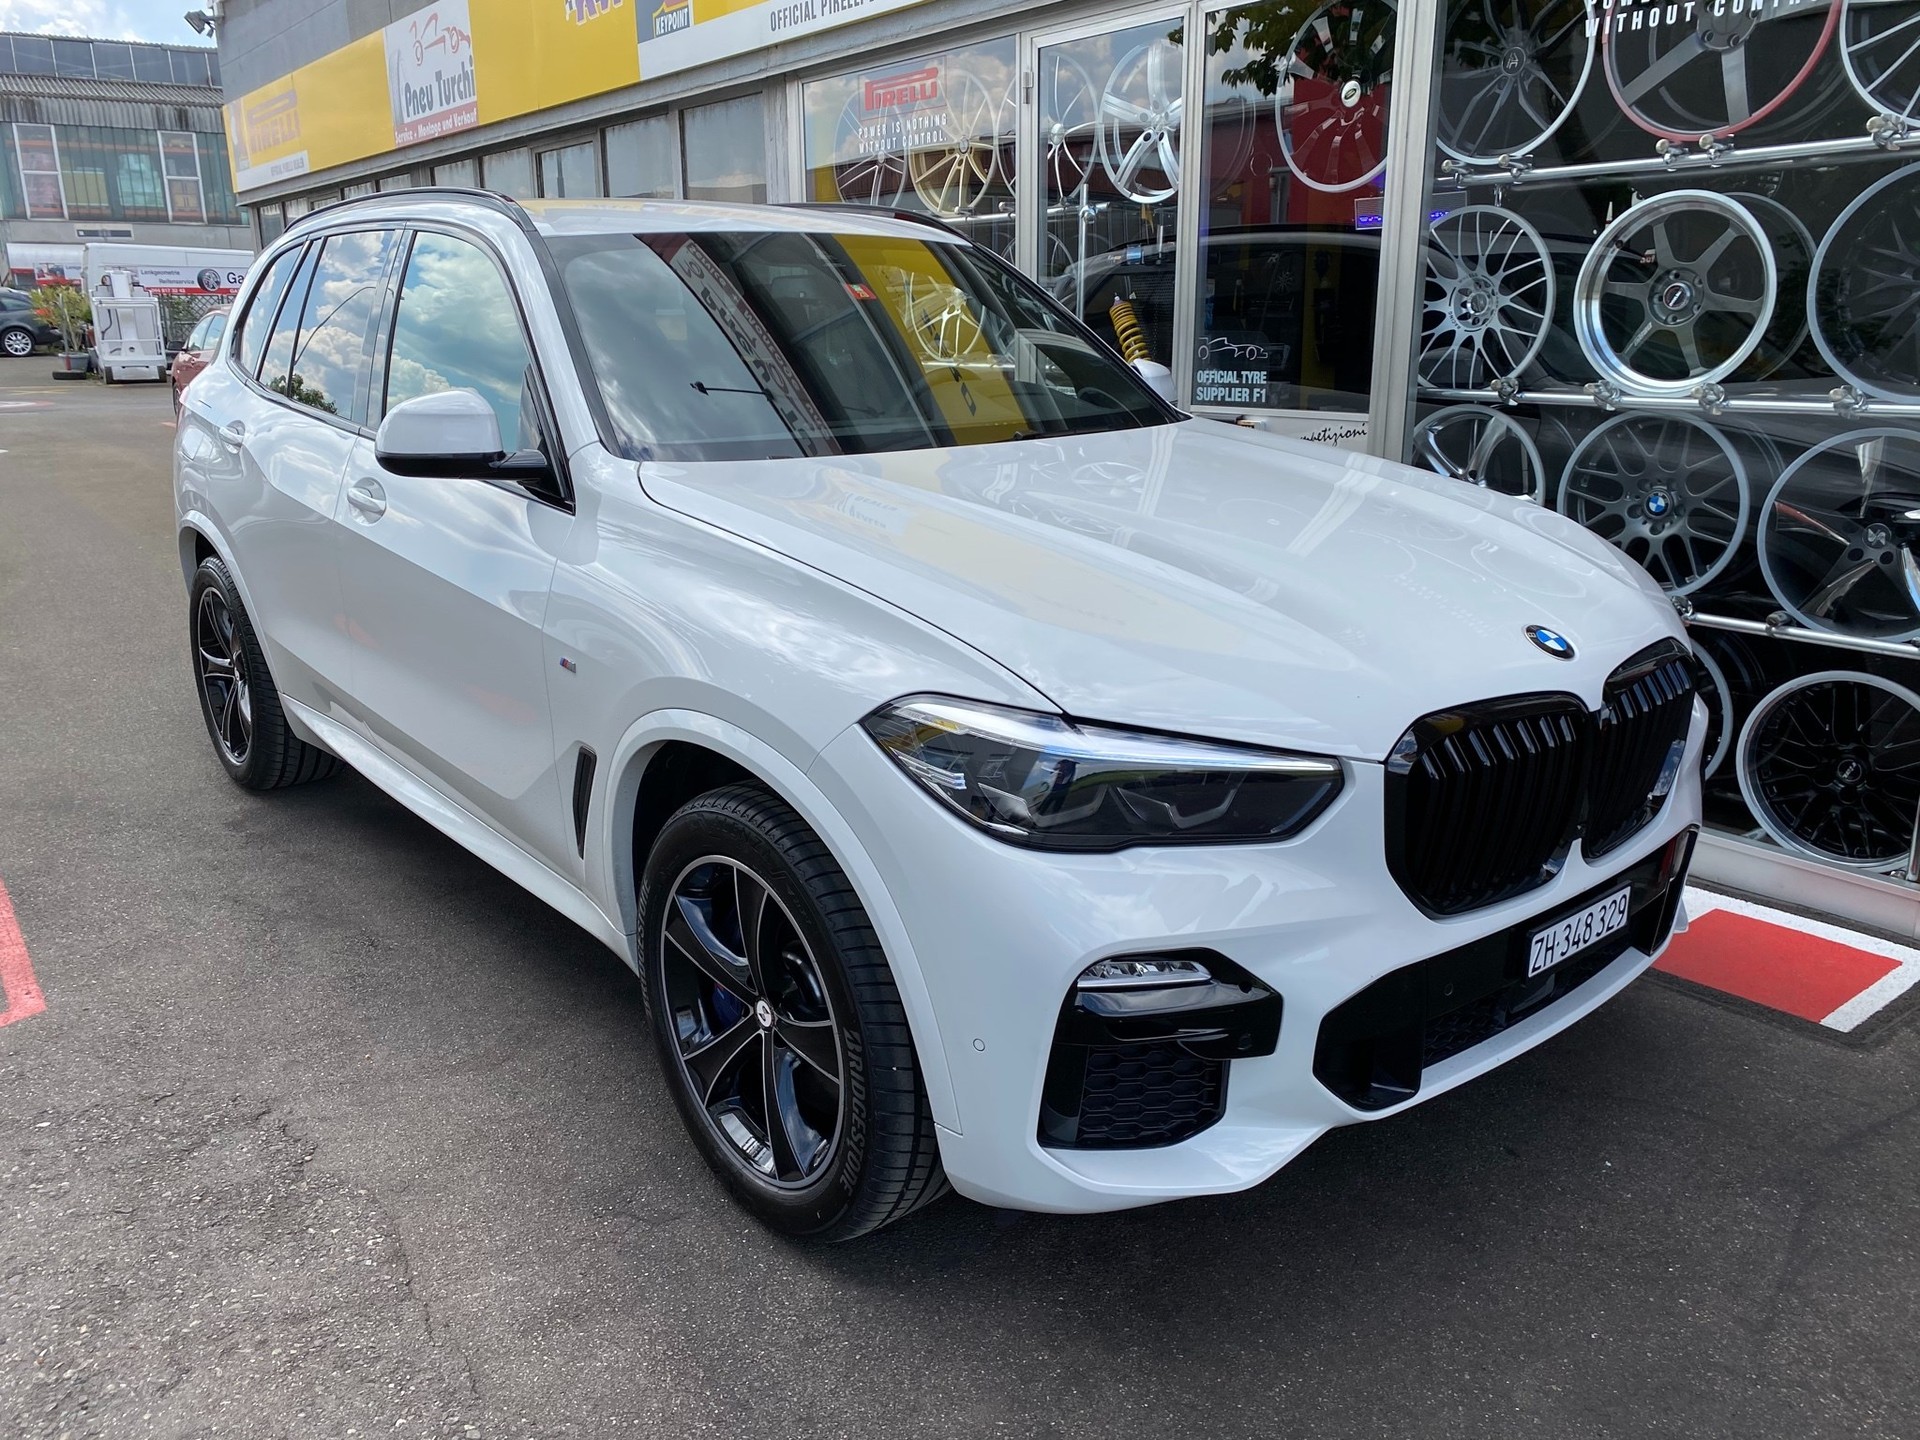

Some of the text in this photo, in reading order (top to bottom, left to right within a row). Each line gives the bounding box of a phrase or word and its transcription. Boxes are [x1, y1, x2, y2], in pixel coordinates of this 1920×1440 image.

[656, 7, 688, 35] KEYPOINT
[770, 0, 816, 31] OFFICIAL
[1585, 1, 1695, 38] WITHOUT
[404, 54, 475, 118] Pneu Turchi
[865, 67, 938, 111] PIRELLI
[859, 112, 947, 139] POWER IS NOTHING
[859, 129, 947, 154] WITHOUT CONTROL.
[1196, 370, 1267, 384] OFFICIAL TYRE
[1196, 387, 1267, 402] SUPPLIER F1
[843, 1027, 867, 1196] BRIDGESTONE
